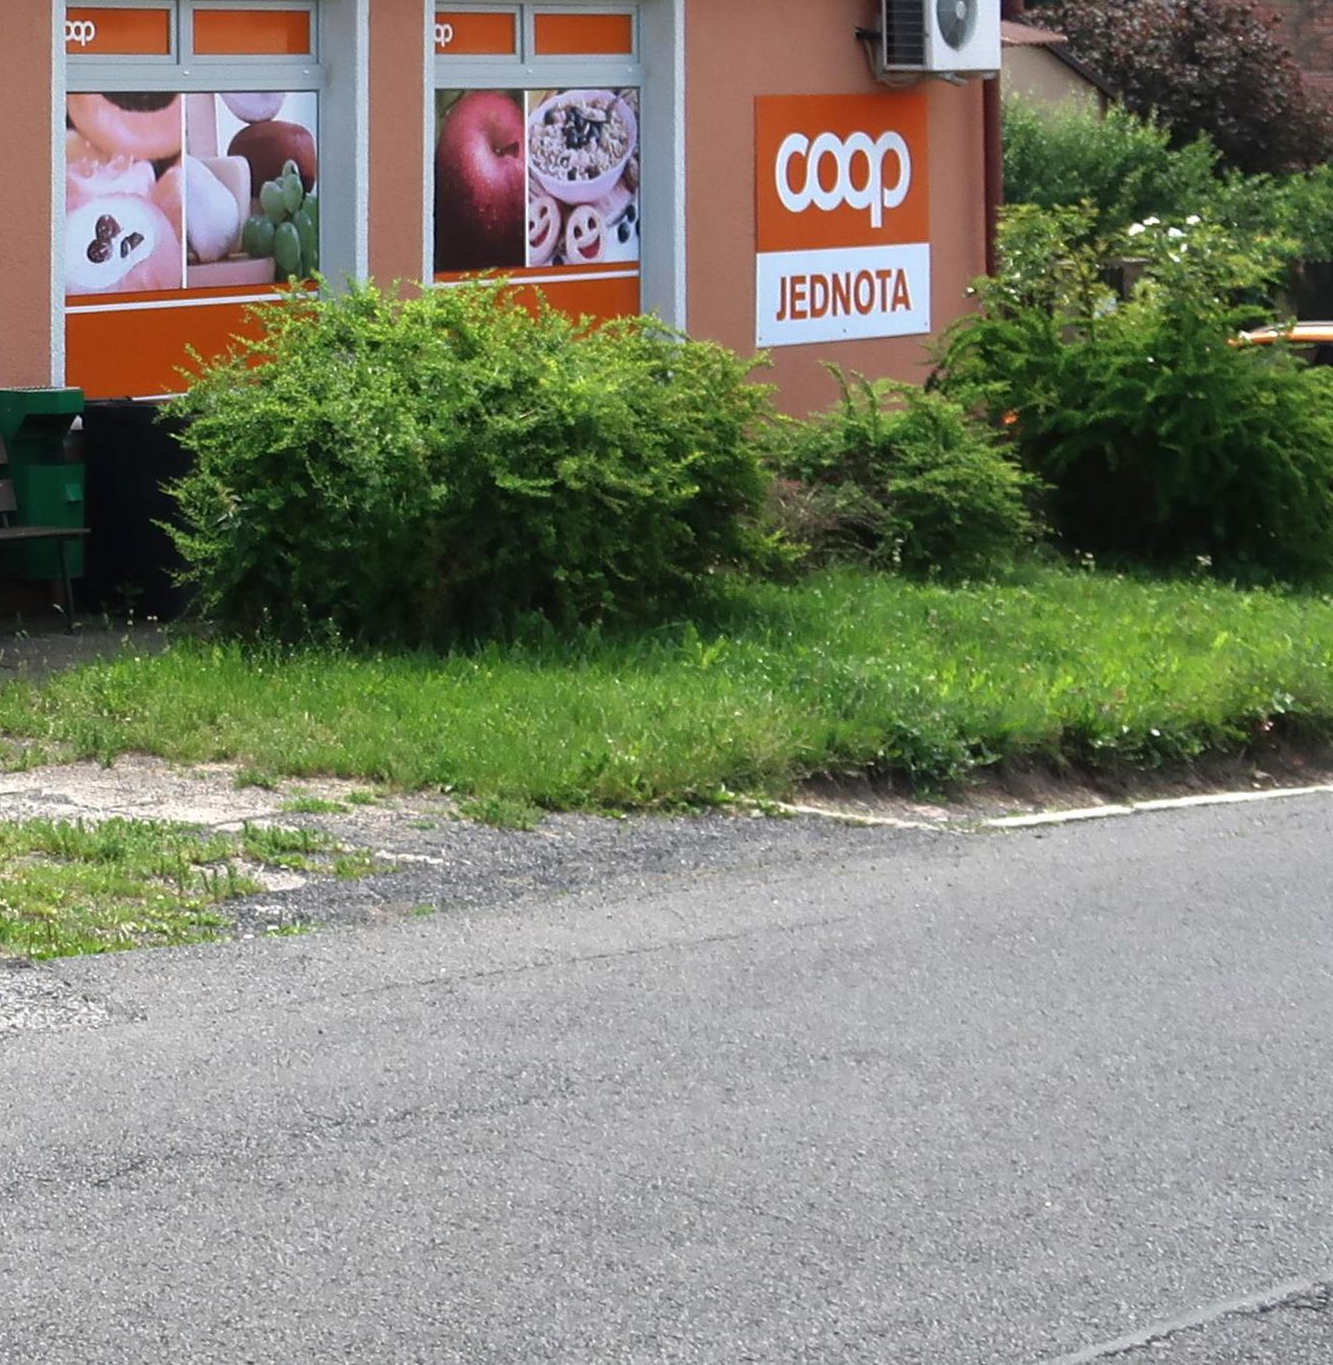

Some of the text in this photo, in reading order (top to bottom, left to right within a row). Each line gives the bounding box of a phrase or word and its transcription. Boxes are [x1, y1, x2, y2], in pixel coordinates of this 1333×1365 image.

[63, 20, 96, 47] oop
[775, 130, 912, 229] coop
[776, 268, 911, 321] JEDNOTA
